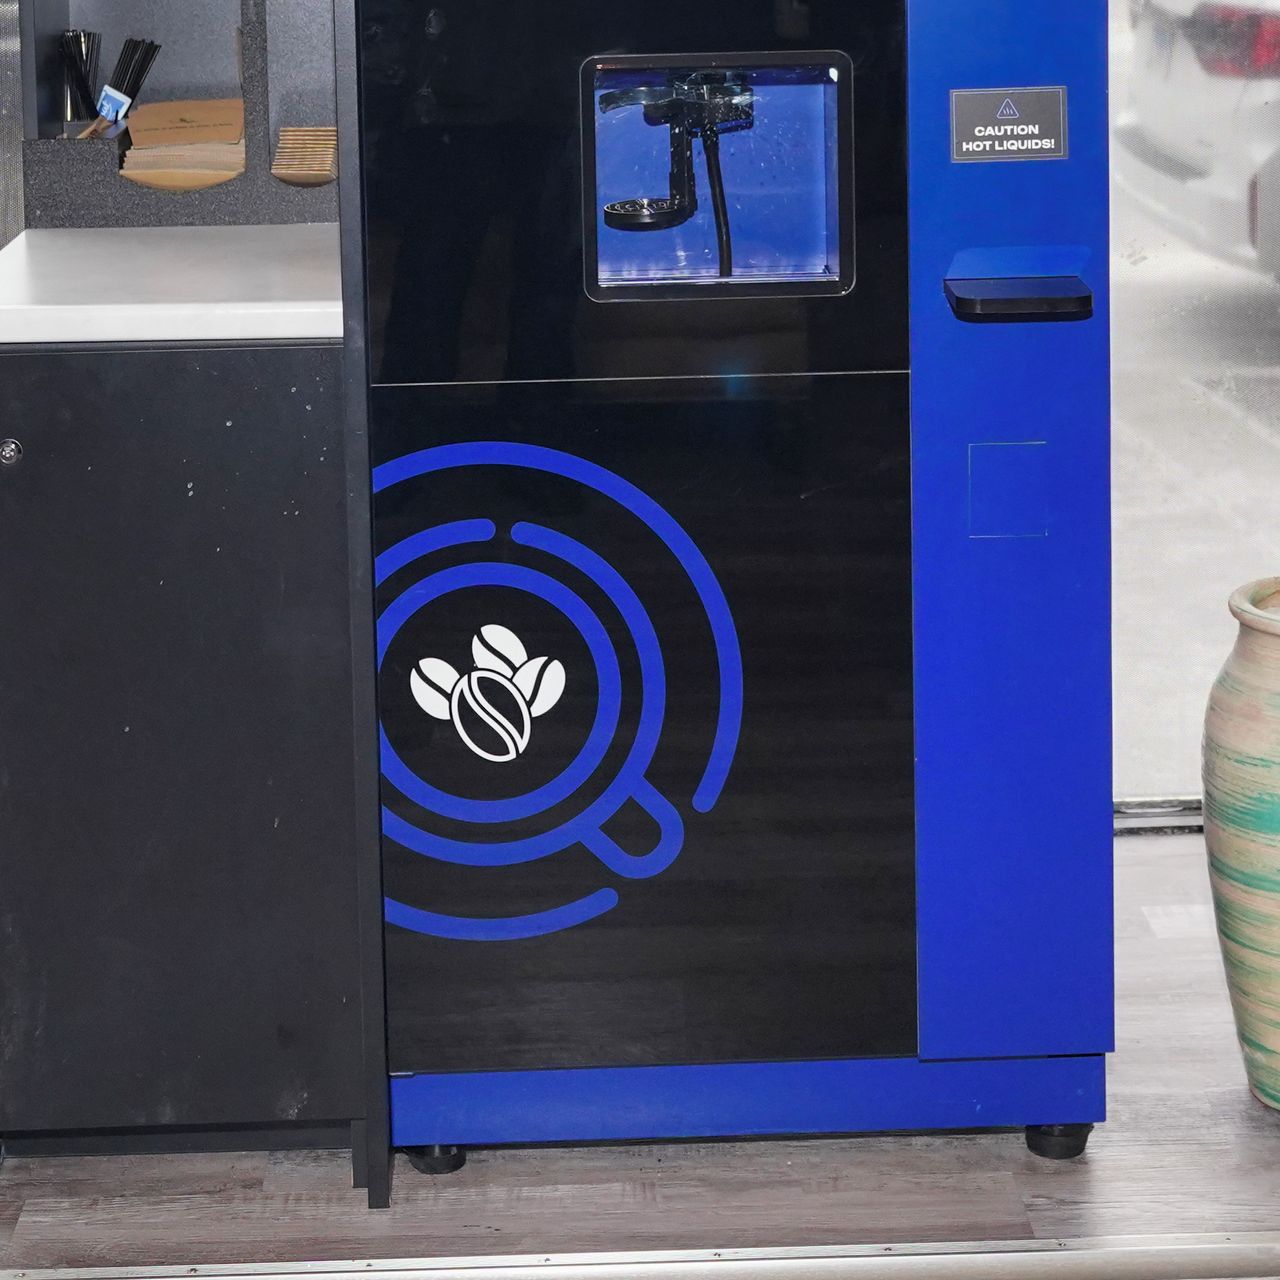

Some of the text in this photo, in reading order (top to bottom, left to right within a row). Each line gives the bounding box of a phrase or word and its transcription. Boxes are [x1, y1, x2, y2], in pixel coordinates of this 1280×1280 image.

[974, 124, 1039, 137] CAUTION
[962, 138, 1055, 152] HOT LIQUIDS!
